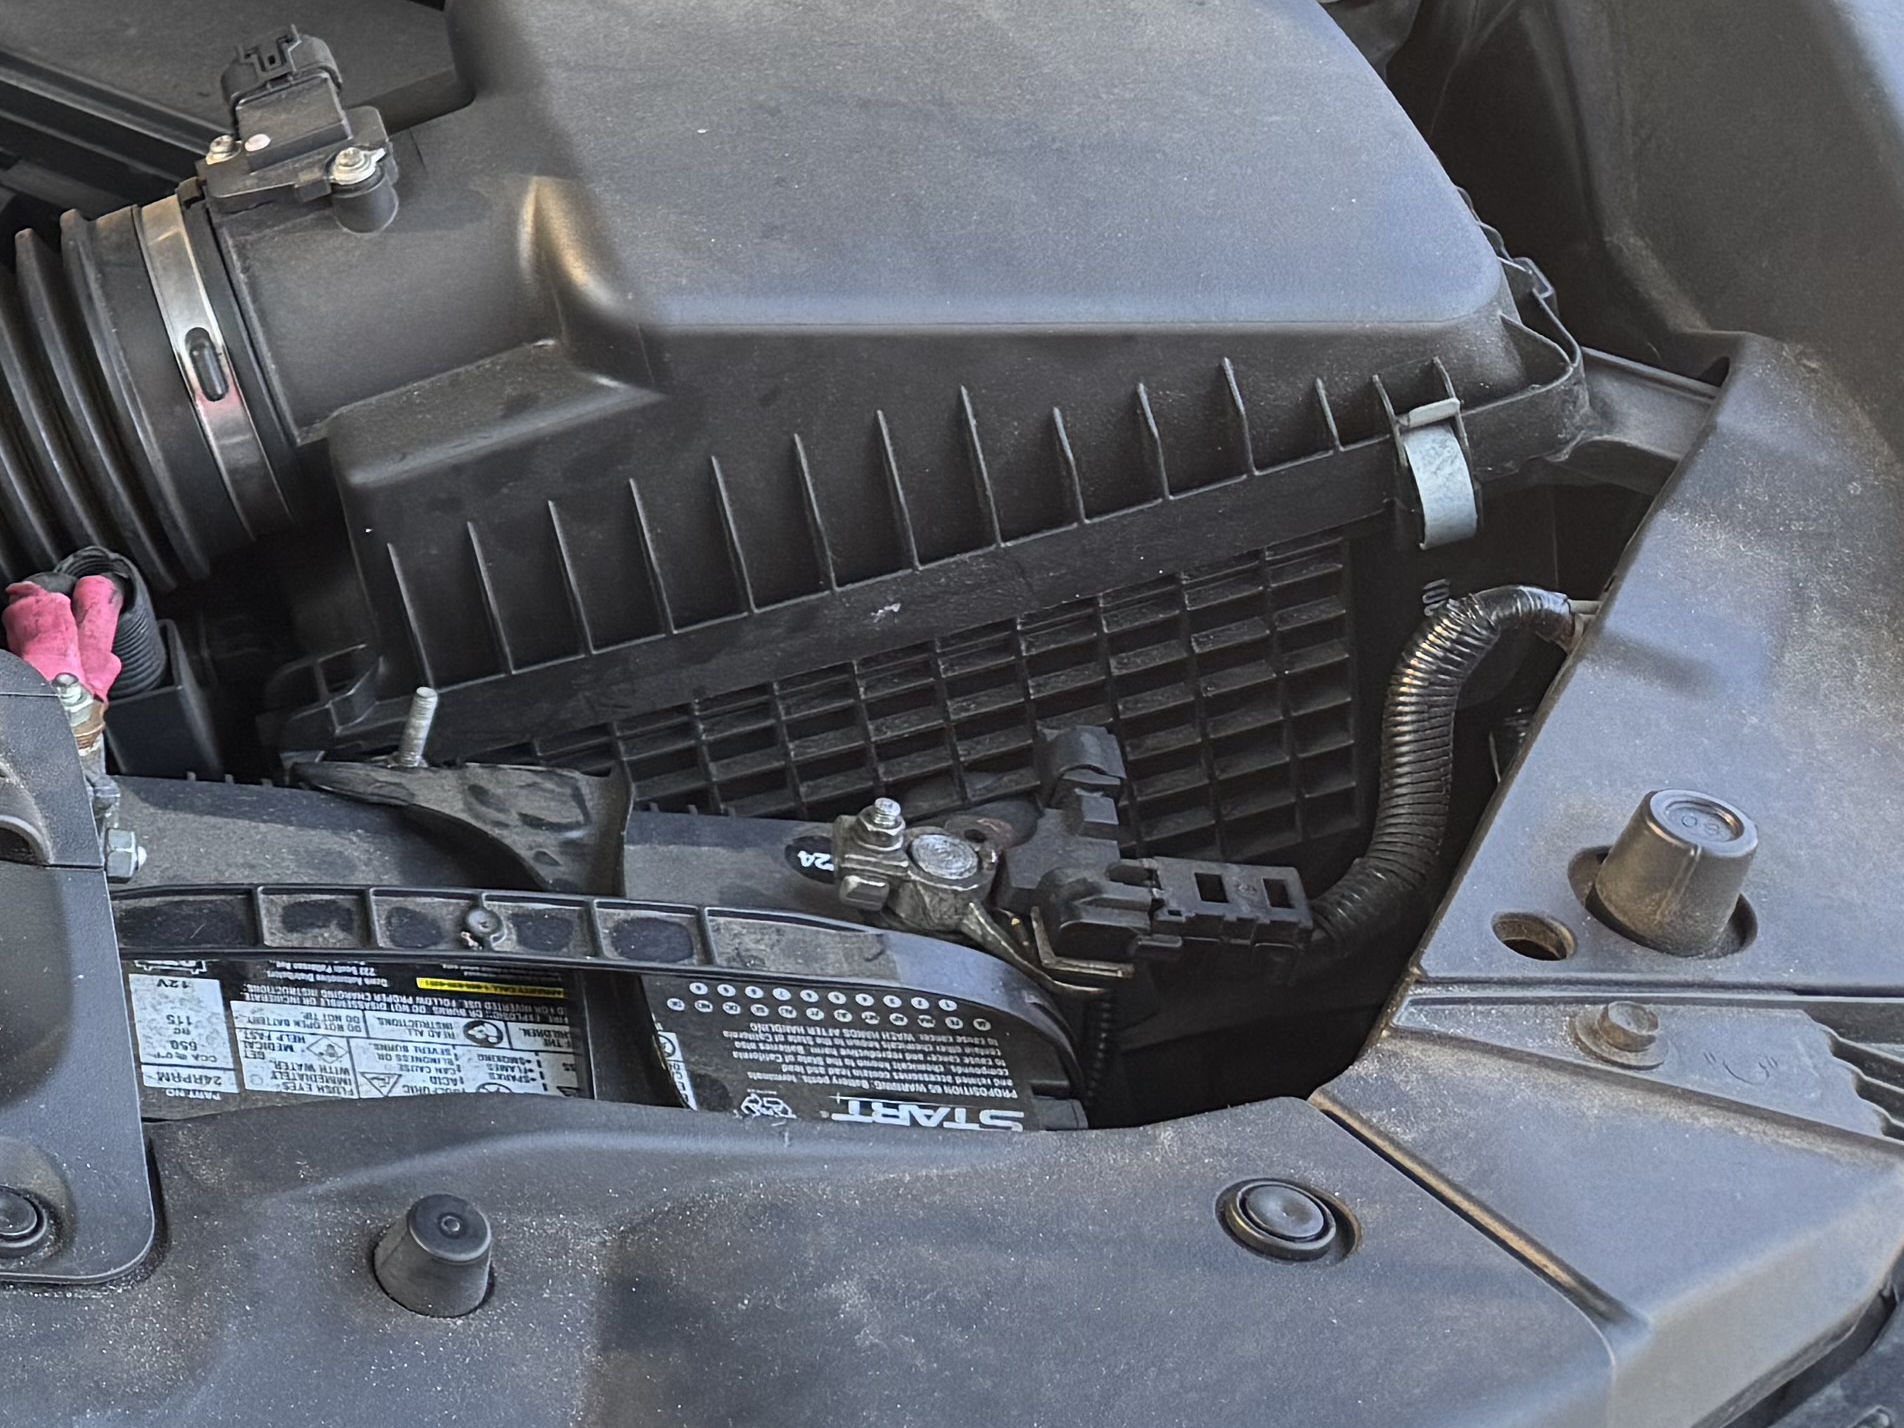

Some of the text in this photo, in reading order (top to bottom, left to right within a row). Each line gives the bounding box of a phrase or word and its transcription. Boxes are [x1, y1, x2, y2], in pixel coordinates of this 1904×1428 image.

[320, 990, 371, 1001] CHARGING
[373, 993, 413, 1004] PROPER
[416, 996, 456, 1007] FOLLOW
[166, 1015, 192, 1026] 115
[323, 1013, 342, 1022] NOT
[346, 1015, 360, 1023] DO
[293, 1020, 321, 1029] OPEN
[324, 1022, 344, 1032] NOT
[347, 1024, 362, 1032] DO
[406, 1028, 456, 1040] READ ALL
[806, 1026, 840, 1037] AFTER
[842, 1029, 880, 1040] HANDS
[882, 1031, 916, 1042] WASH
[276, 1034, 306, 1044] HELP
[241, 1040, 294, 1052] MEDICAL
[191, 1054, 217, 1062] CCA
[244, 1050, 265, 1060] GET
[376, 1053, 454, 1066] BLINDNESS OR
[732, 1051, 782, 1063] California
[319, 1065, 350, 1076] WITH
[397, 1064, 456, 1075] CAN CAUSE
[271, 1071, 352, 1086] IMMEDIATELY
[430, 1076, 458, 1086] ACID
[892, 1072, 952, 1083] accessories
[317, 1085, 354, 1096] FLUSH
[943, 1084, 1018, 1098] PROPOSITION
[831, 1100, 1024, 1132] START
